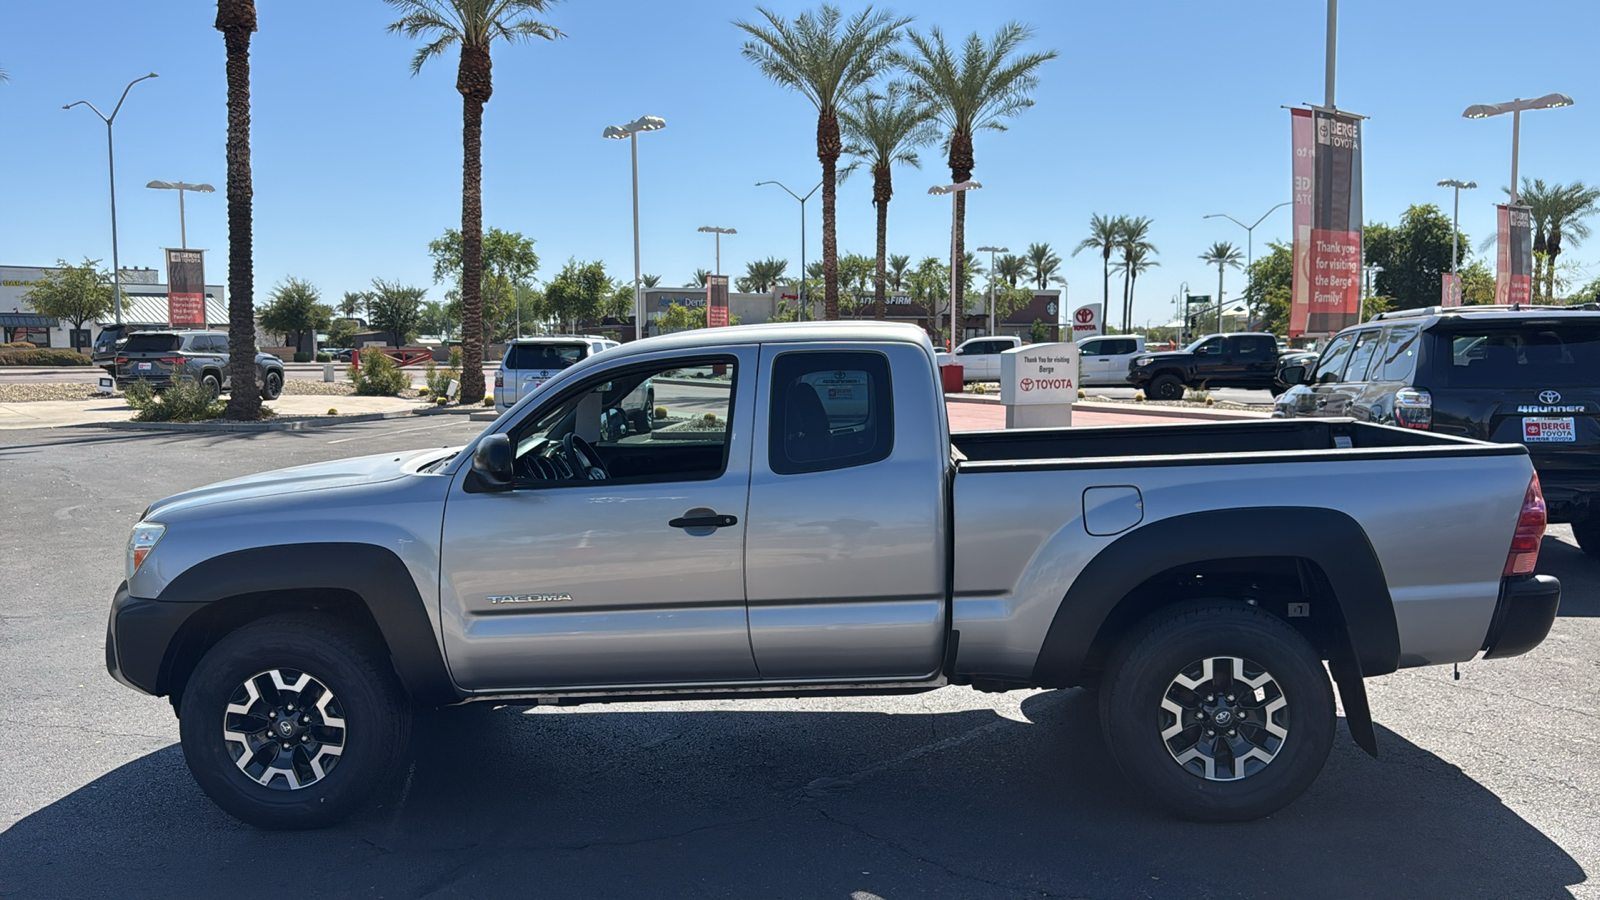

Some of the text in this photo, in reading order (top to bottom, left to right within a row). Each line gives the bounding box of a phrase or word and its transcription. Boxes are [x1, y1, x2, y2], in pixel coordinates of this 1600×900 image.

[1330, 118, 1358, 138] BERGE
[1330, 137, 1359, 150] TOYOTA
[1316, 240, 1356, 256] Thank you
[1315, 257, 1357, 273] for visiting
[1315, 275, 1352, 289] the Berge
[1313, 291, 1343, 306] Family!
[1039, 365, 1054, 374] Berge
[1035, 379, 1072, 389] TOYOTA
[486, 592, 573, 604] TACOMA
